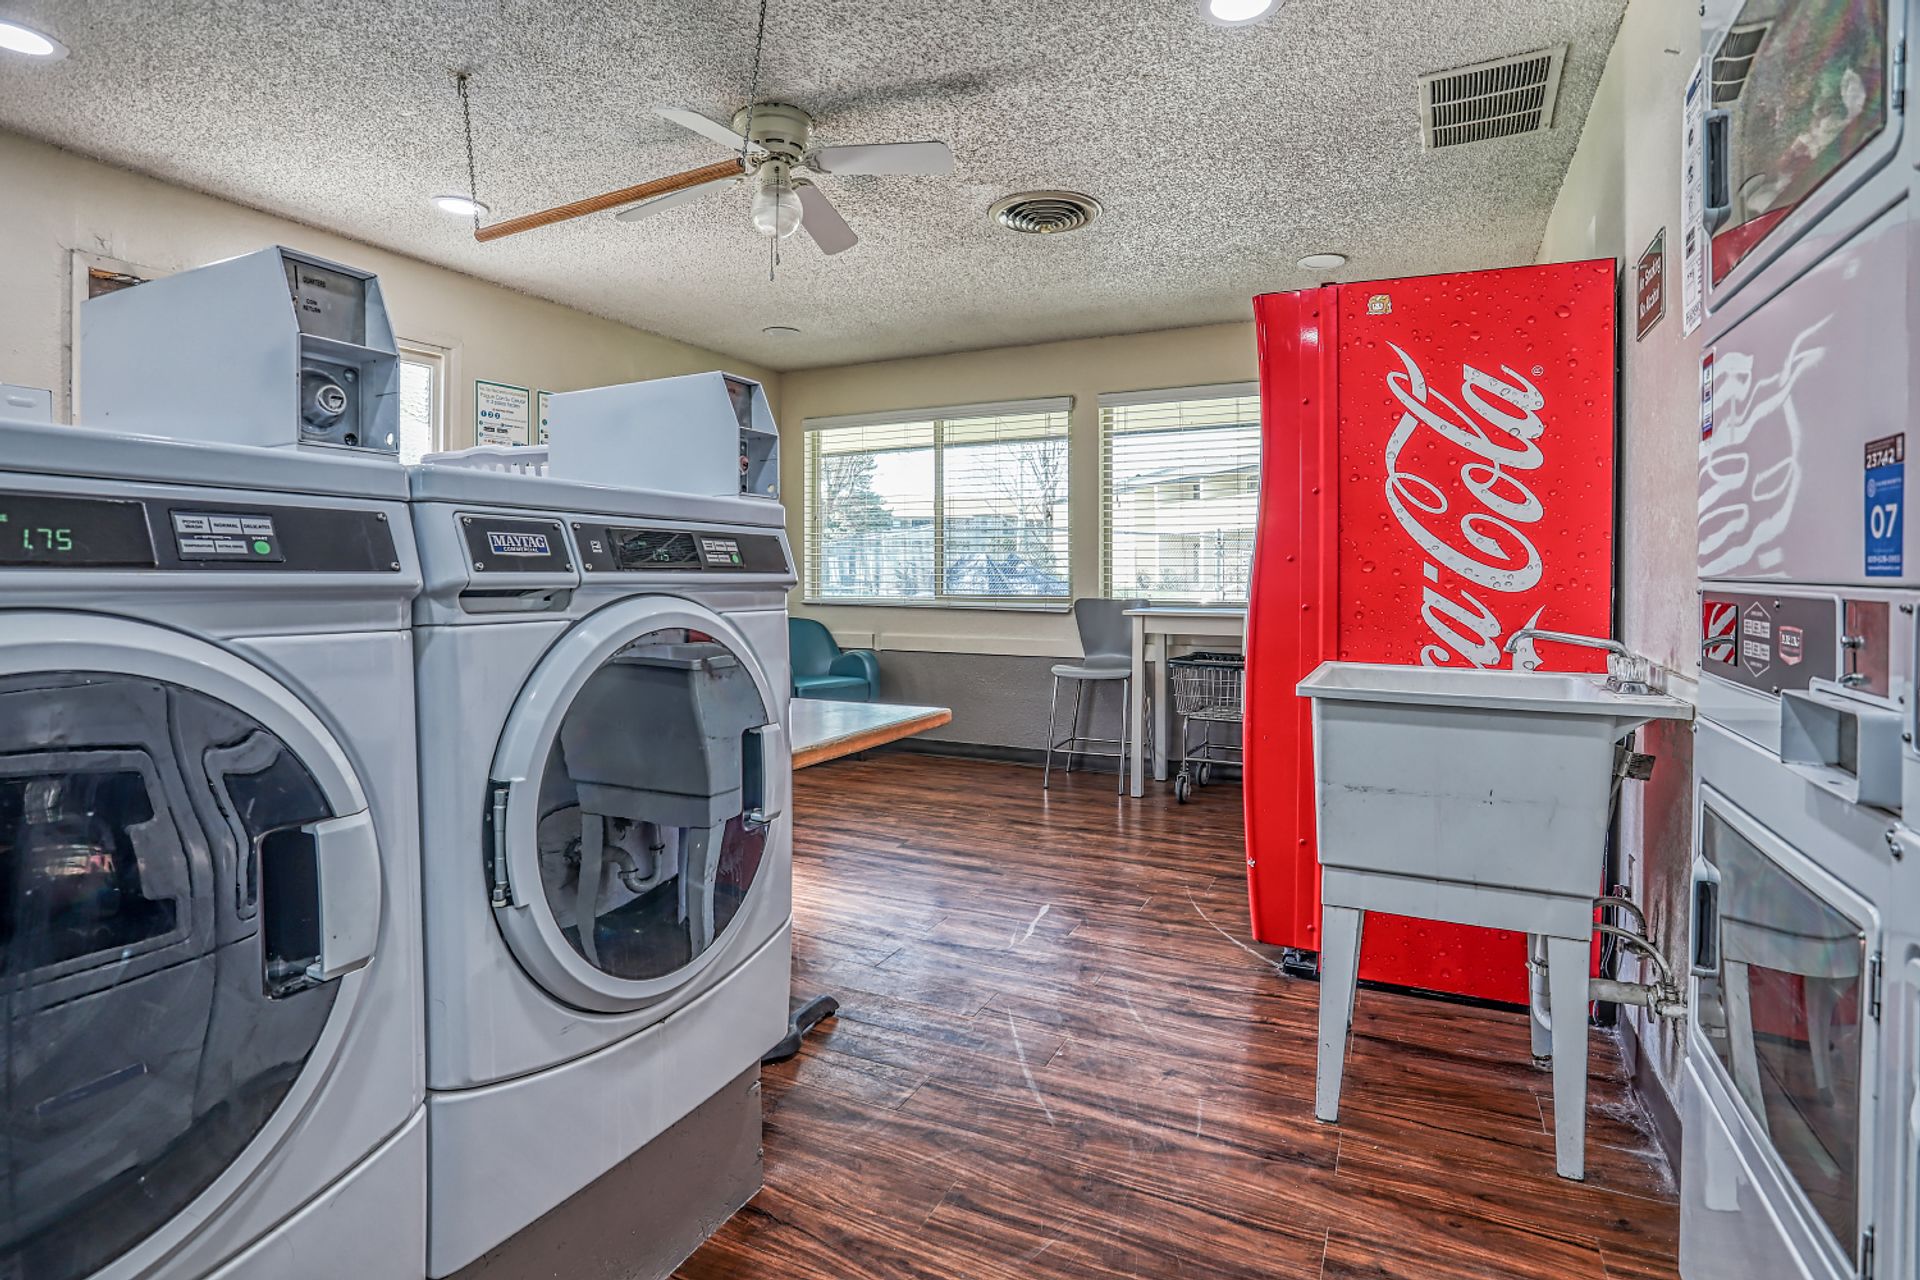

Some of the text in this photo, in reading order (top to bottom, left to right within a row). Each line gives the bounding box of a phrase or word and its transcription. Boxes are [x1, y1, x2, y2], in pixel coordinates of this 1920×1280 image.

[303, 276, 326, 288] QUARTERS
[303, 304, 321, 313] RETURN
[1870, 503, 1898, 539] 07
[24, 528, 72, 550] 1.75
[491, 535, 545, 548] MAYTAG
